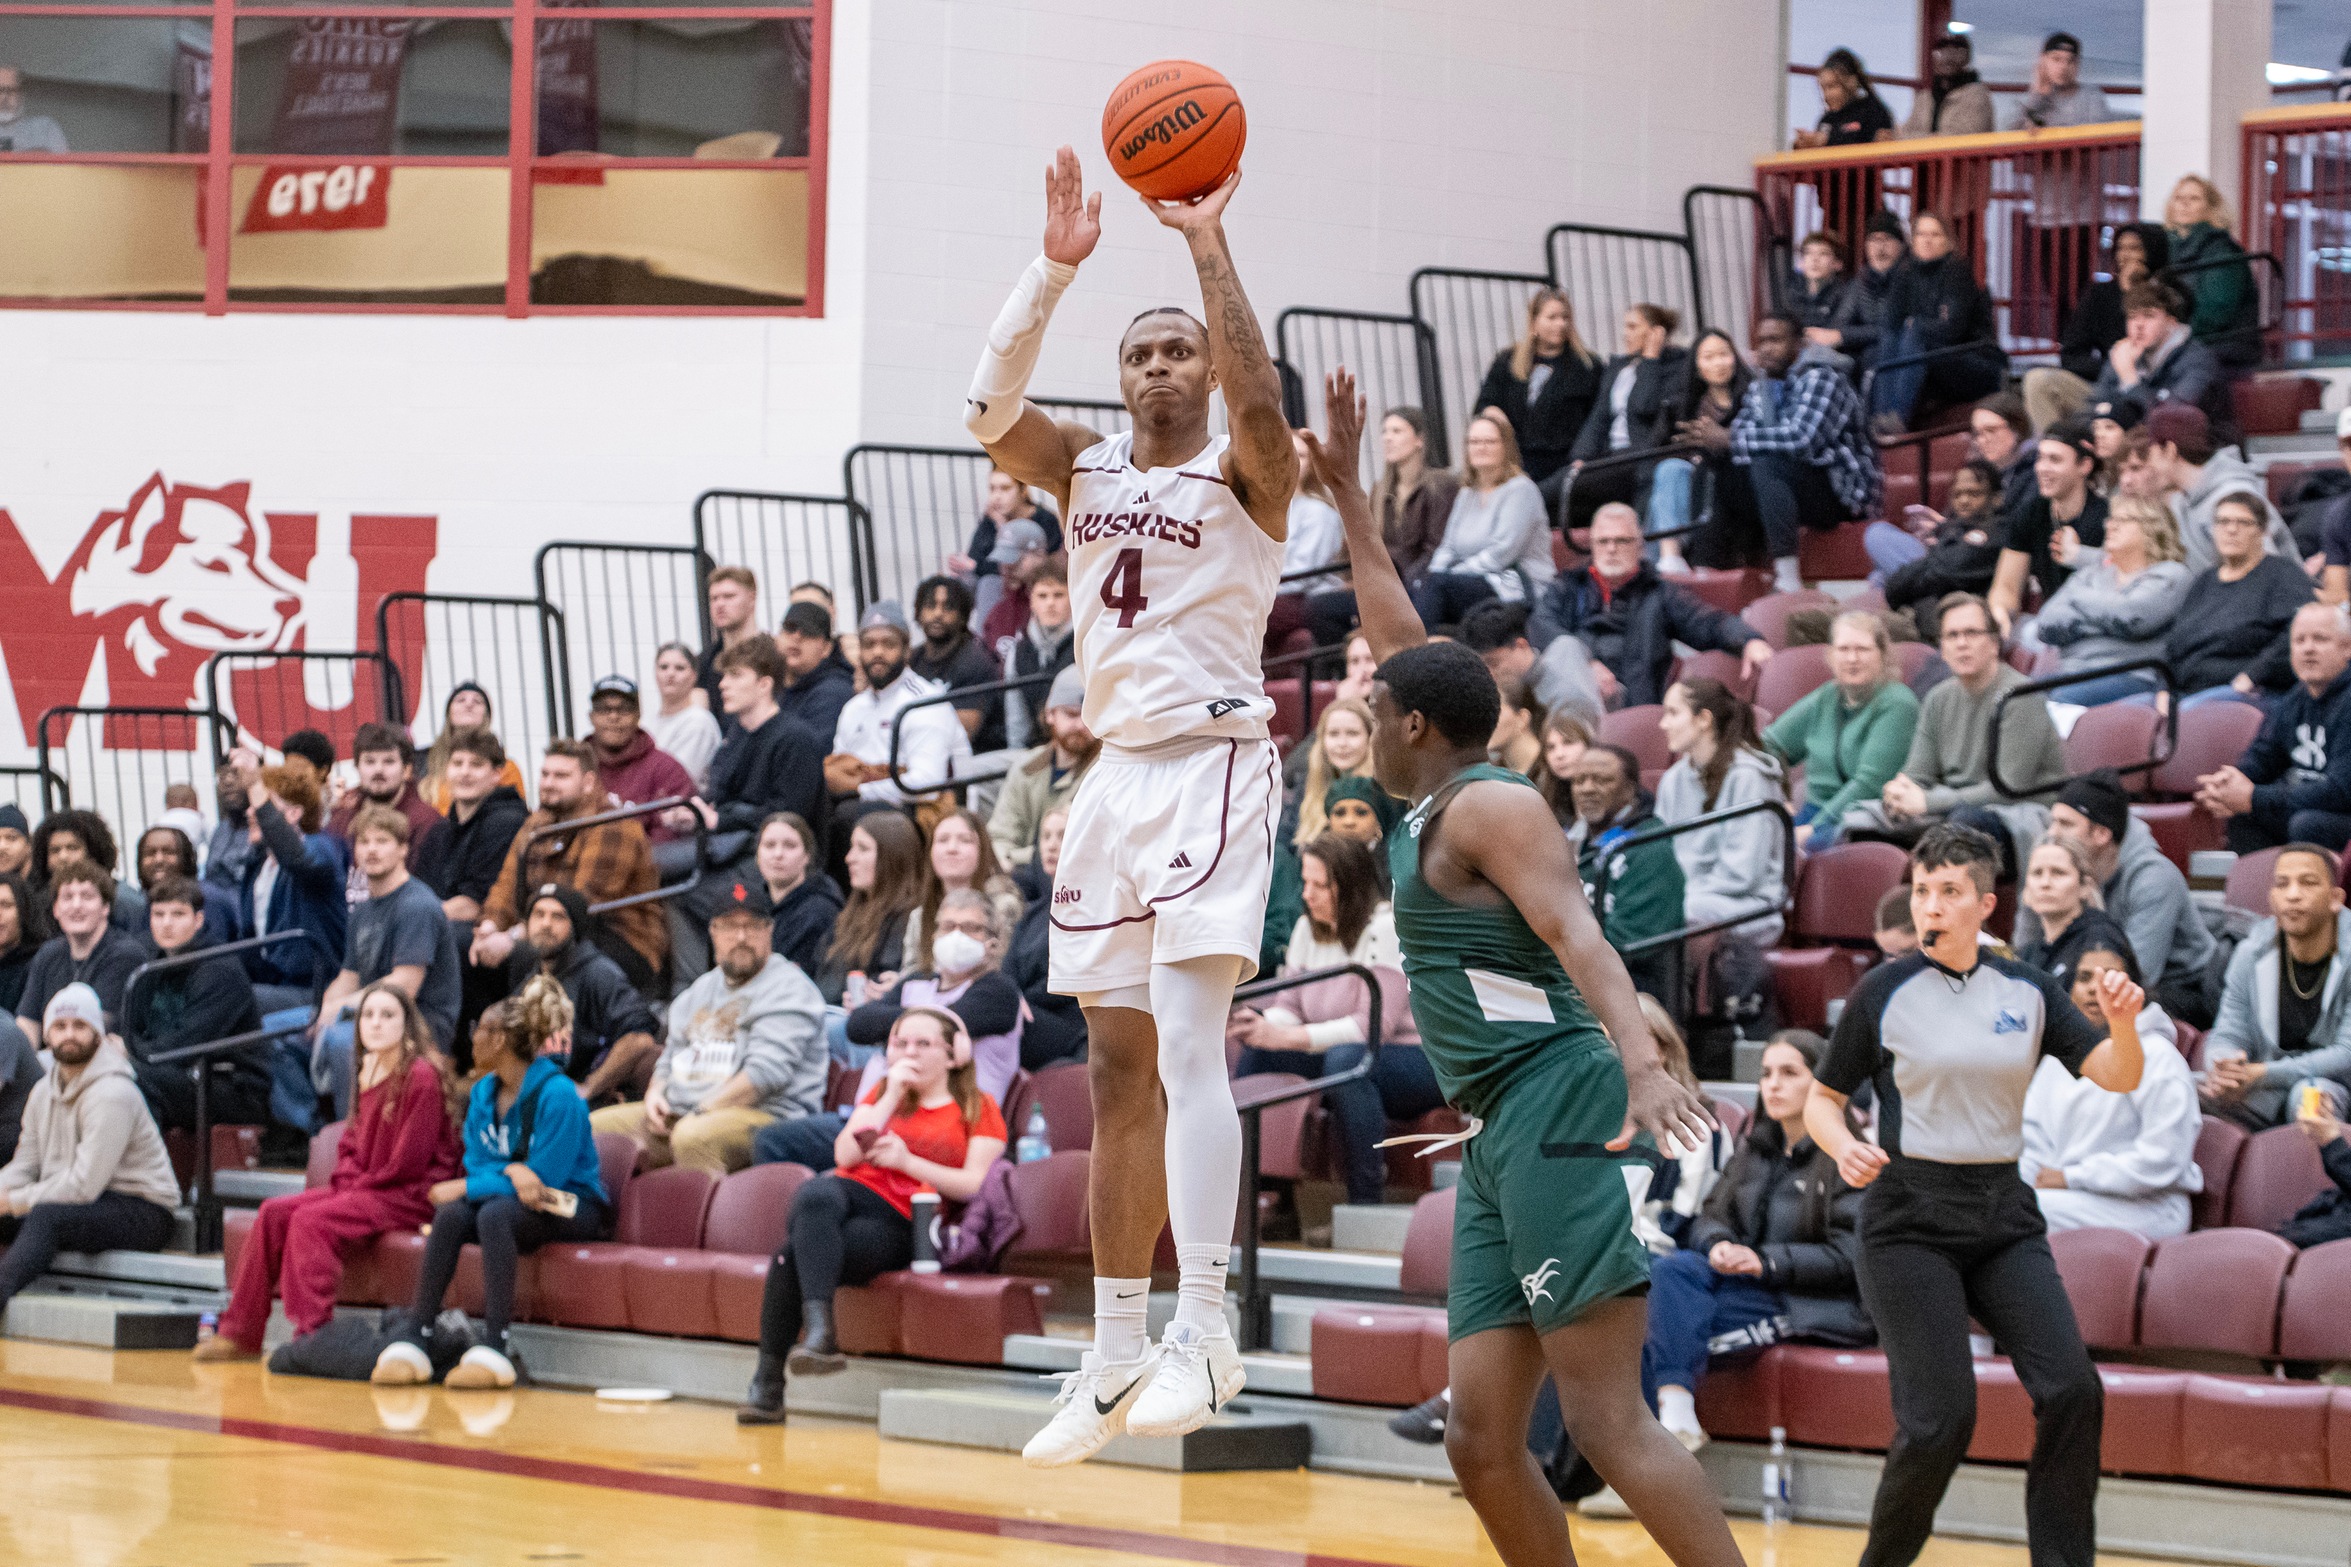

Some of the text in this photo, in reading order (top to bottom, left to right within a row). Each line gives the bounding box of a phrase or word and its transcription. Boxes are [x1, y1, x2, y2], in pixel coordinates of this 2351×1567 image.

[1107, 68, 1181, 127] EVOLUTION
[1120, 99, 1209, 161] Wilson
[1072, 512, 1203, 550] HUSKIES
[1100, 548, 1149, 628] 4
